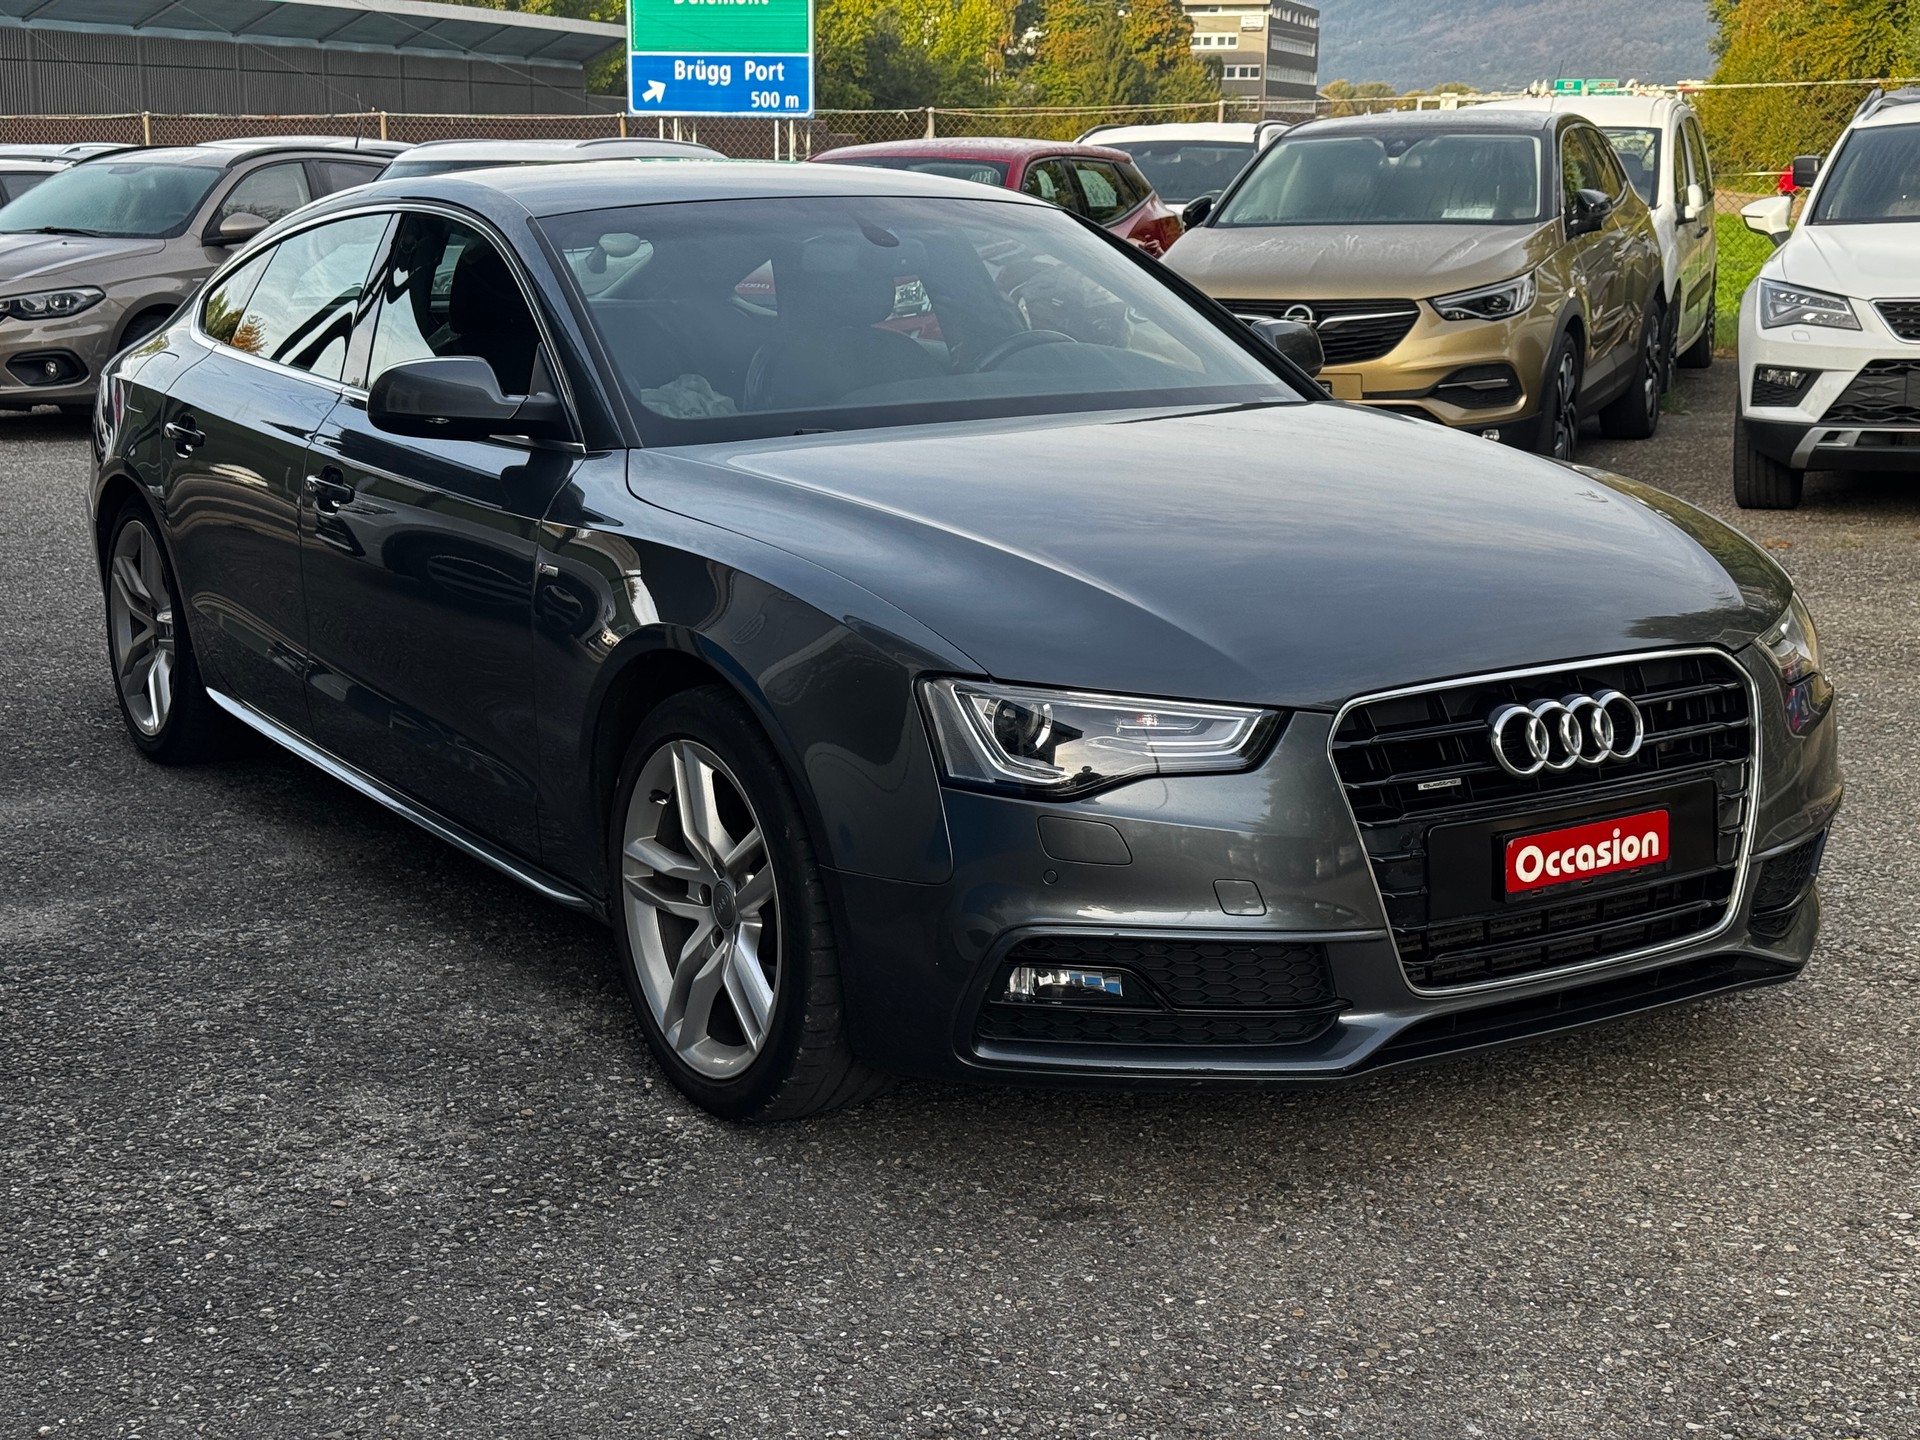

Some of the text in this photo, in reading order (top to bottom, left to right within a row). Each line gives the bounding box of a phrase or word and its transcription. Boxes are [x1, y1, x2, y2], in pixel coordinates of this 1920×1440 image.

[674, 59, 785, 86] Brügg Port
[751, 91, 799, 109] 500 m
[1515, 827, 1660, 883] Occasion
